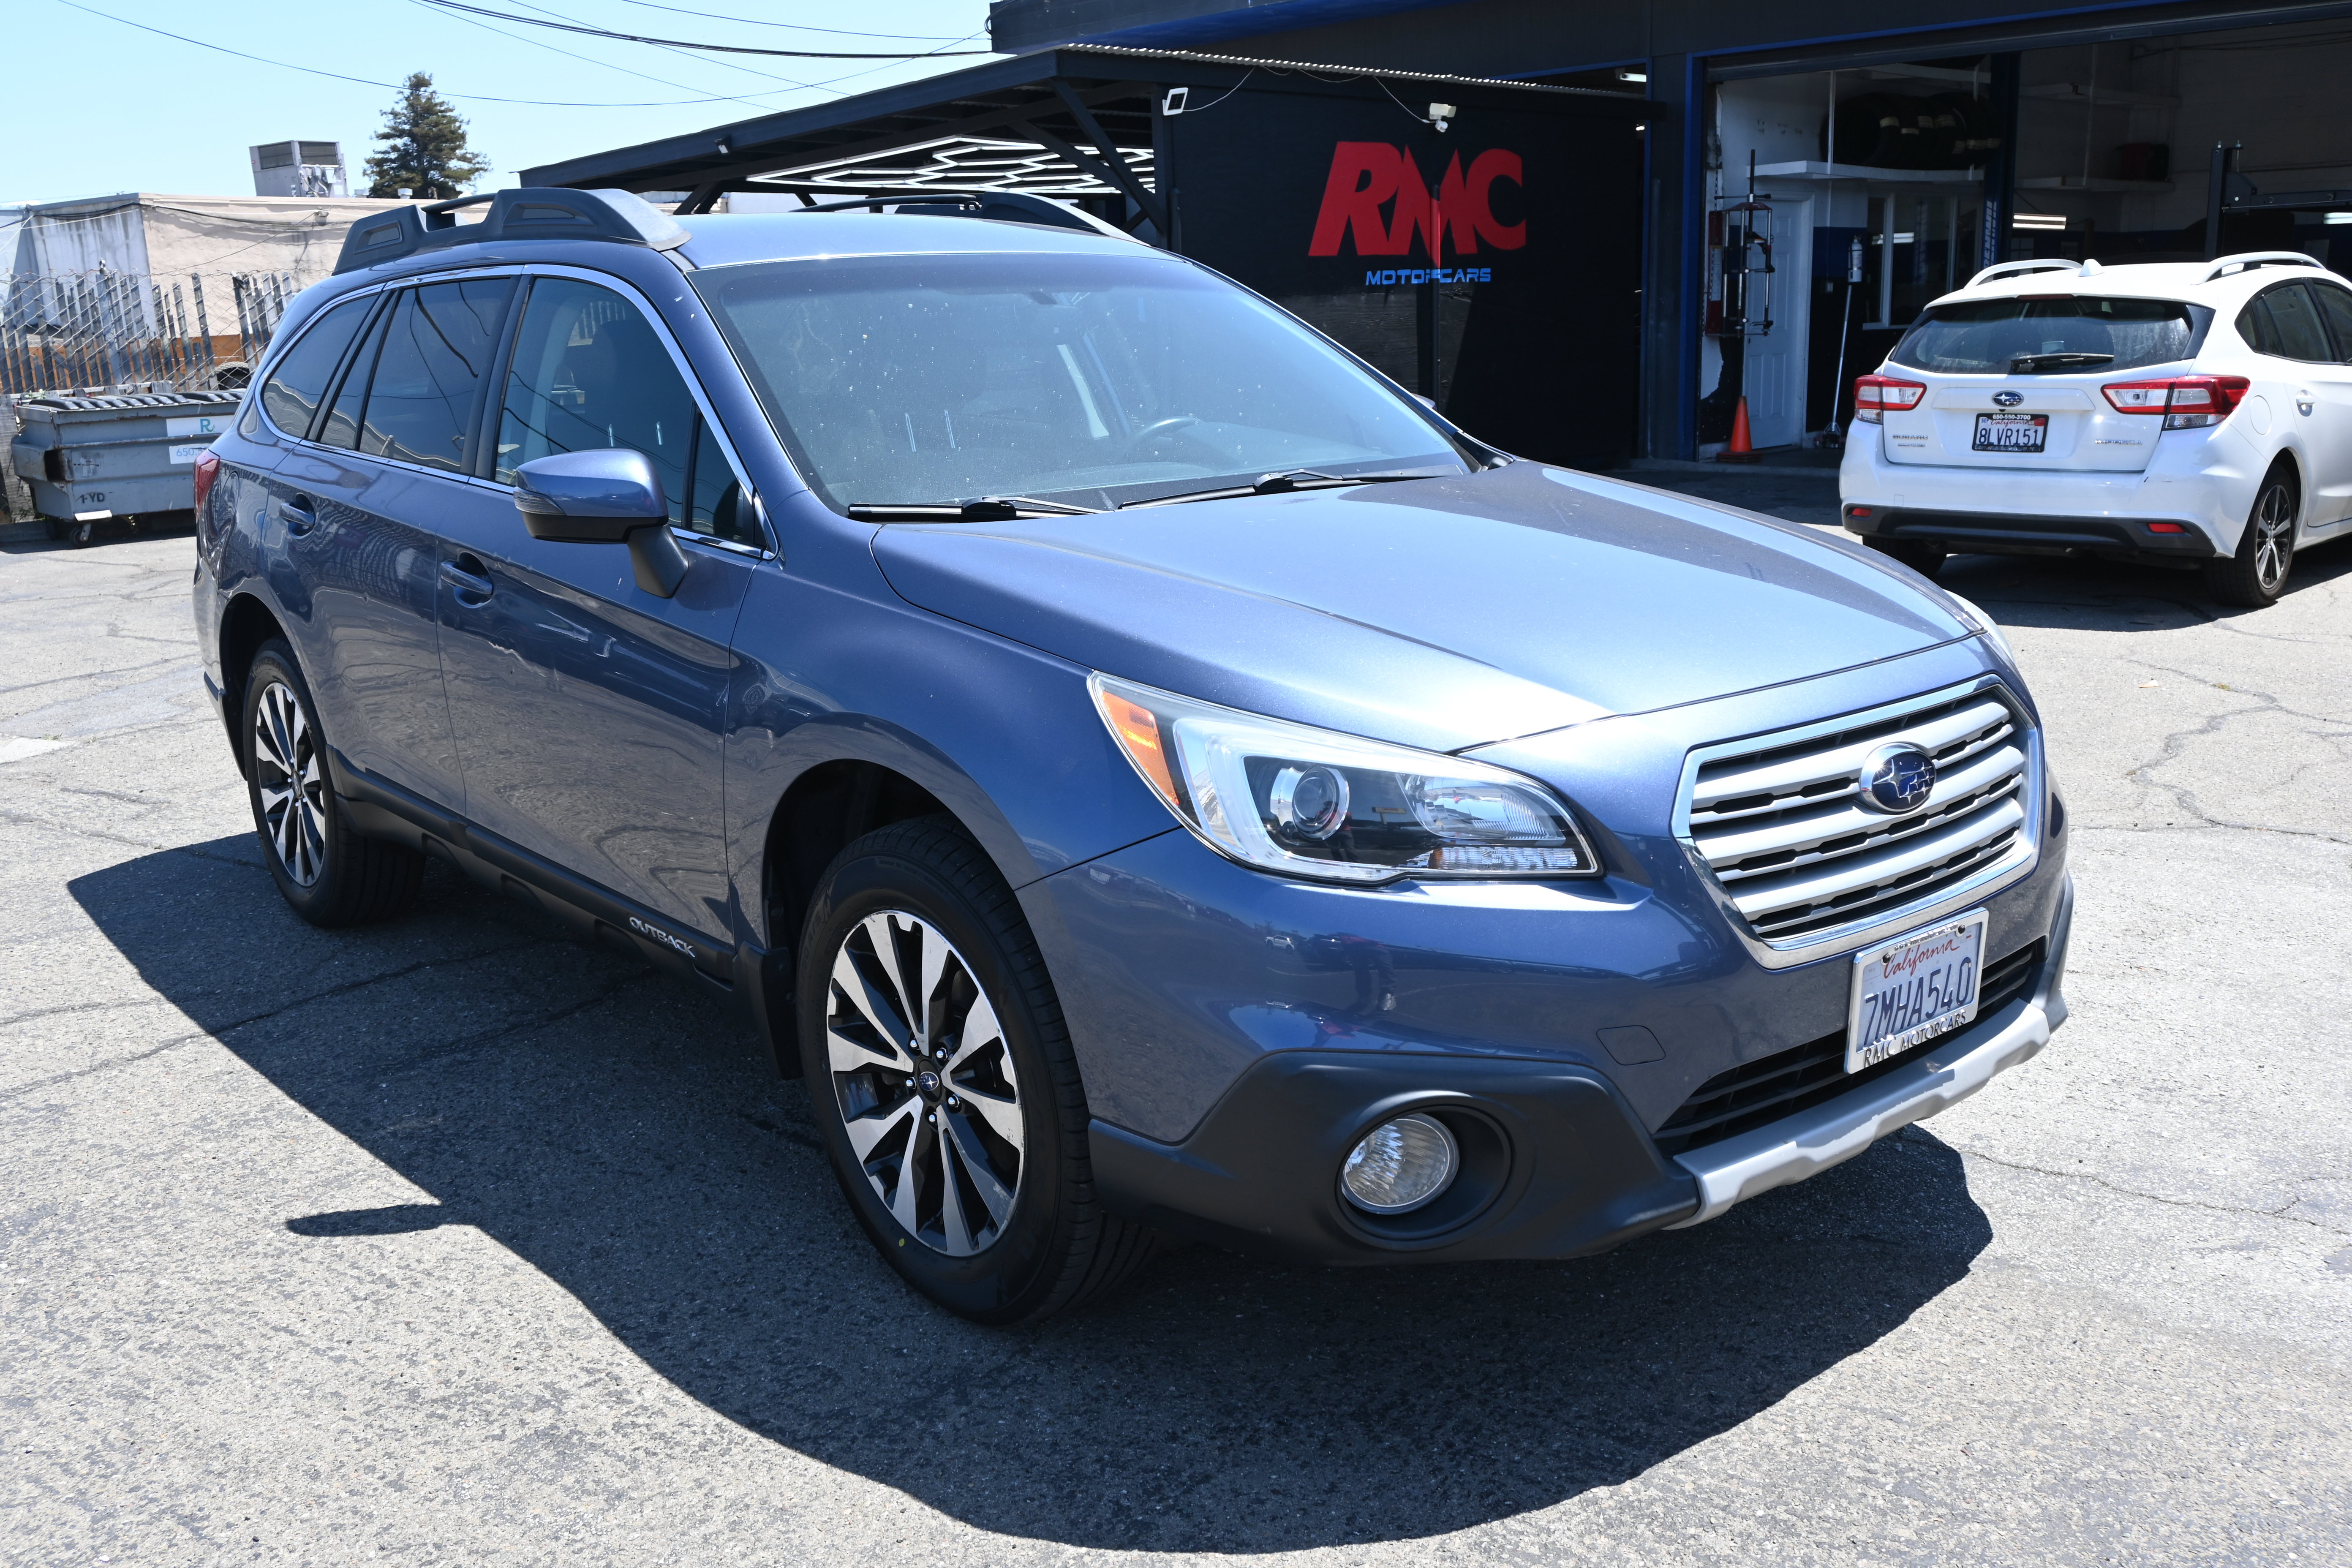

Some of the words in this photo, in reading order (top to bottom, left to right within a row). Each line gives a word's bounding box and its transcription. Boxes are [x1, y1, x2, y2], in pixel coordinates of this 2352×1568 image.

[1308, 141, 1526, 268] RMC
[1366, 268, 1491, 285] MOTORCARS
[1979, 427, 2039, 446] 8LVR151
[1991, 419, 2034, 427] California
[255, 656, 281, 671] SINCERA
[629, 916, 696, 958] OUTBACK
[1884, 935, 1960, 979] California
[1864, 956, 1972, 1046] 7MHA540
[1863, 1033, 1896, 1068] RMC
[1900, 1009, 1967, 1051] MOTORCARS
